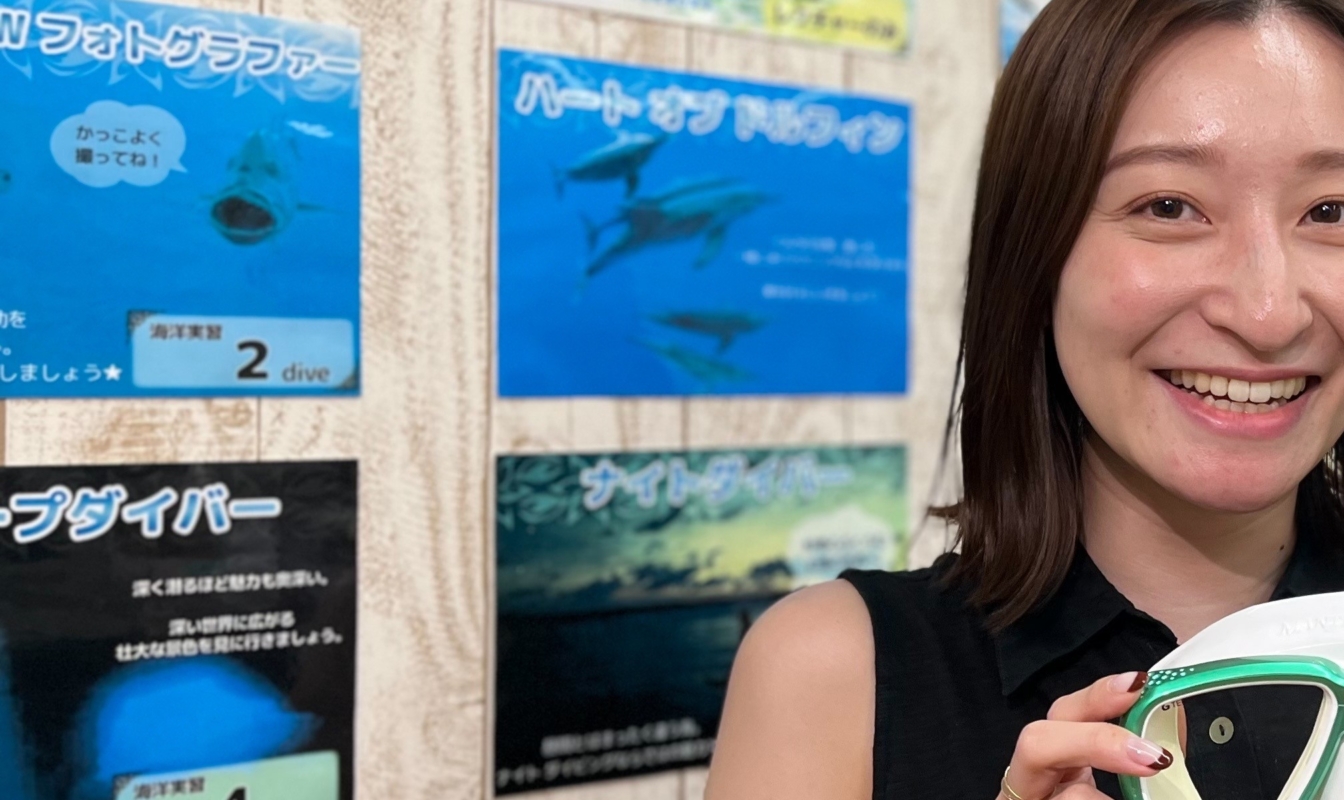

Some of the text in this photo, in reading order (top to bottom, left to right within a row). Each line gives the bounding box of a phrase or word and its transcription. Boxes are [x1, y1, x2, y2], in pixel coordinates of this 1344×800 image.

[36, 13, 361, 80] フォトグラファー
[514, 71, 642, 127] ハート
[75, 124, 162, 147] かっこよく
[75, 148, 160, 169] 撮ってね！
[150, 323, 223, 341] 海洋実習
[236, 340, 331, 384] 2 dive
[580, 454, 852, 511] ナイトダイバー
[168, 610, 296, 637] 深い世界に広がる
[114, 626, 343, 663] 壮大な景色を見に行きましょう。
[134, 776, 205, 800] 海洋実習
